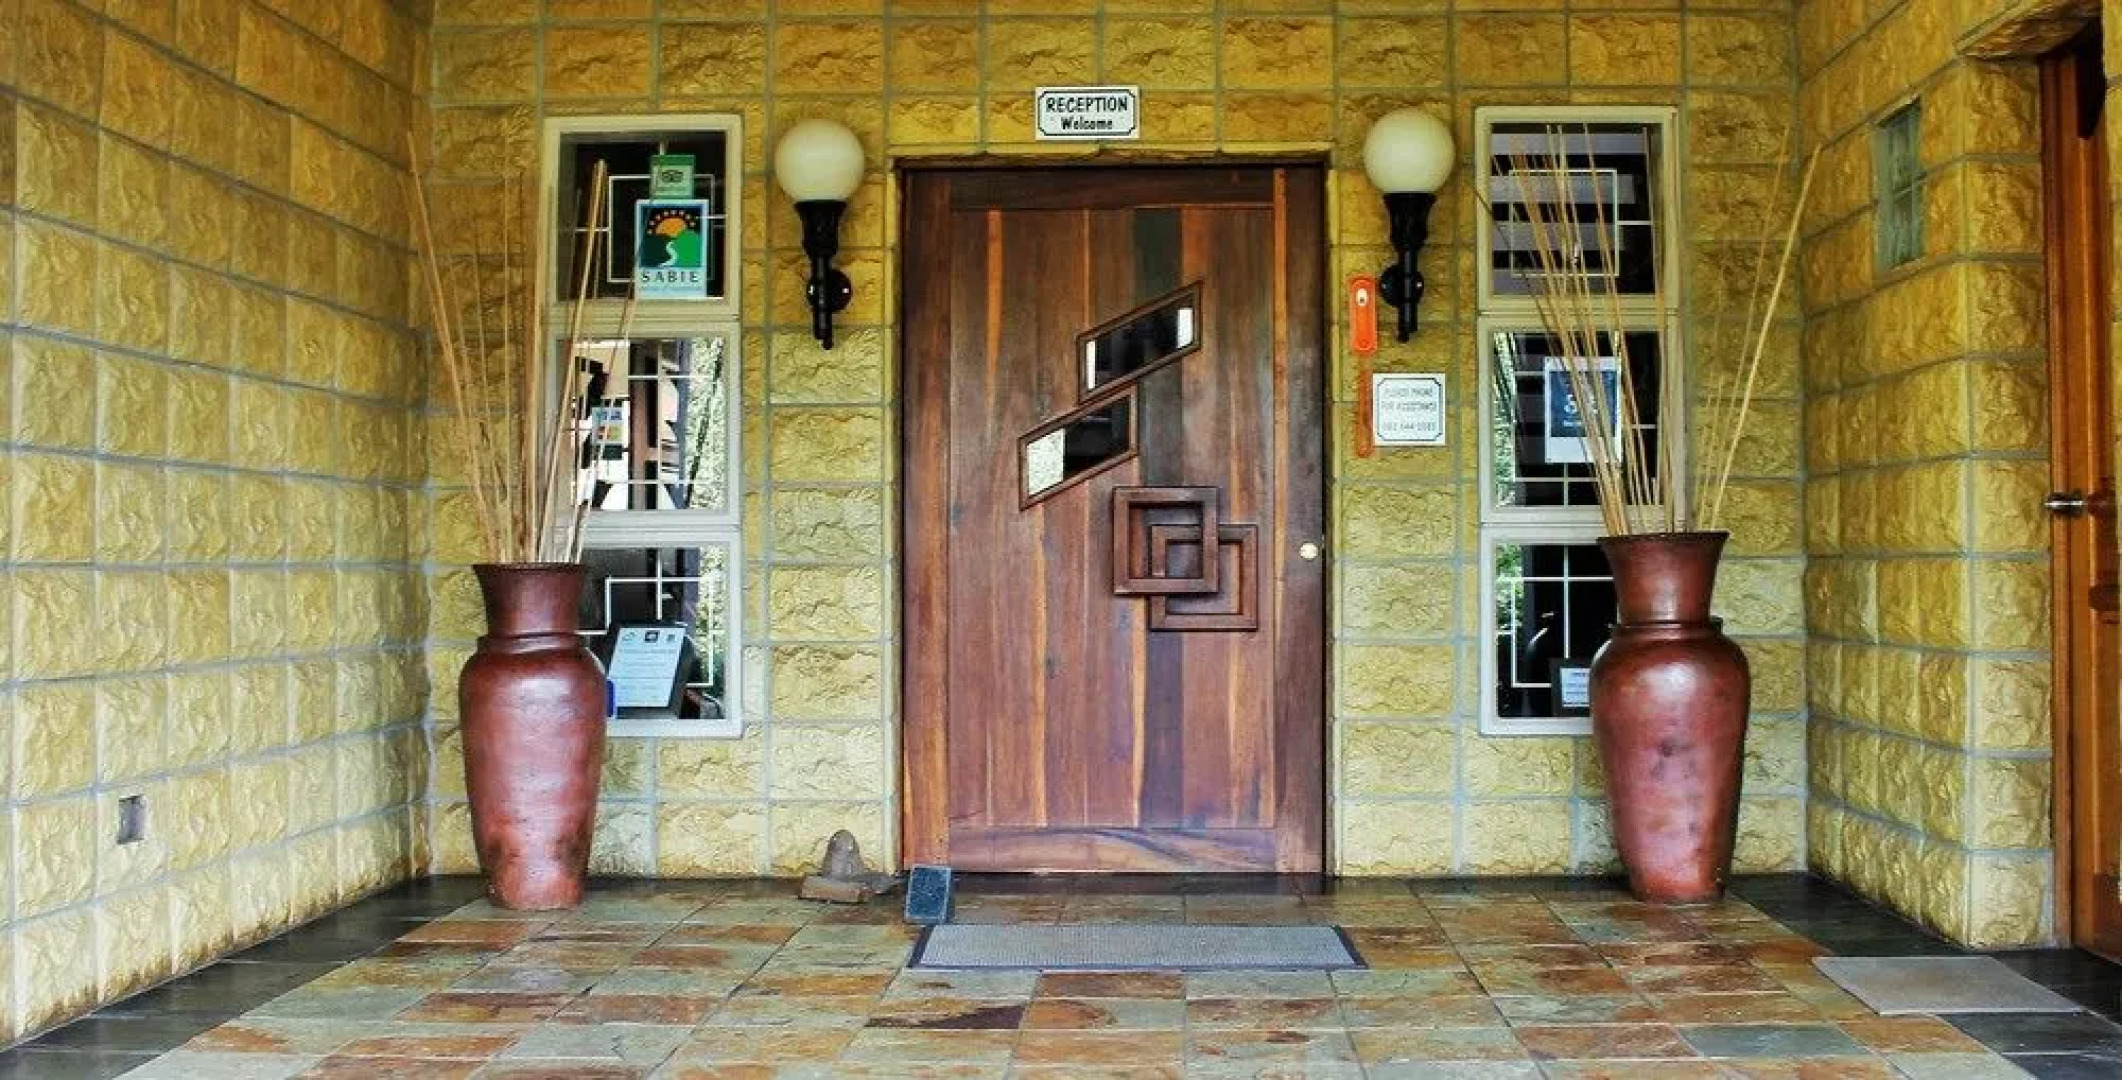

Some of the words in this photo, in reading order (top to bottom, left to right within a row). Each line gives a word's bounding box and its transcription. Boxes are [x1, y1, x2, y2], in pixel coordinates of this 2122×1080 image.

[1046, 97, 1128, 113] RECEPTION
[1061, 116, 1113, 130] Welcome
[641, 271, 699, 283] SABIE
